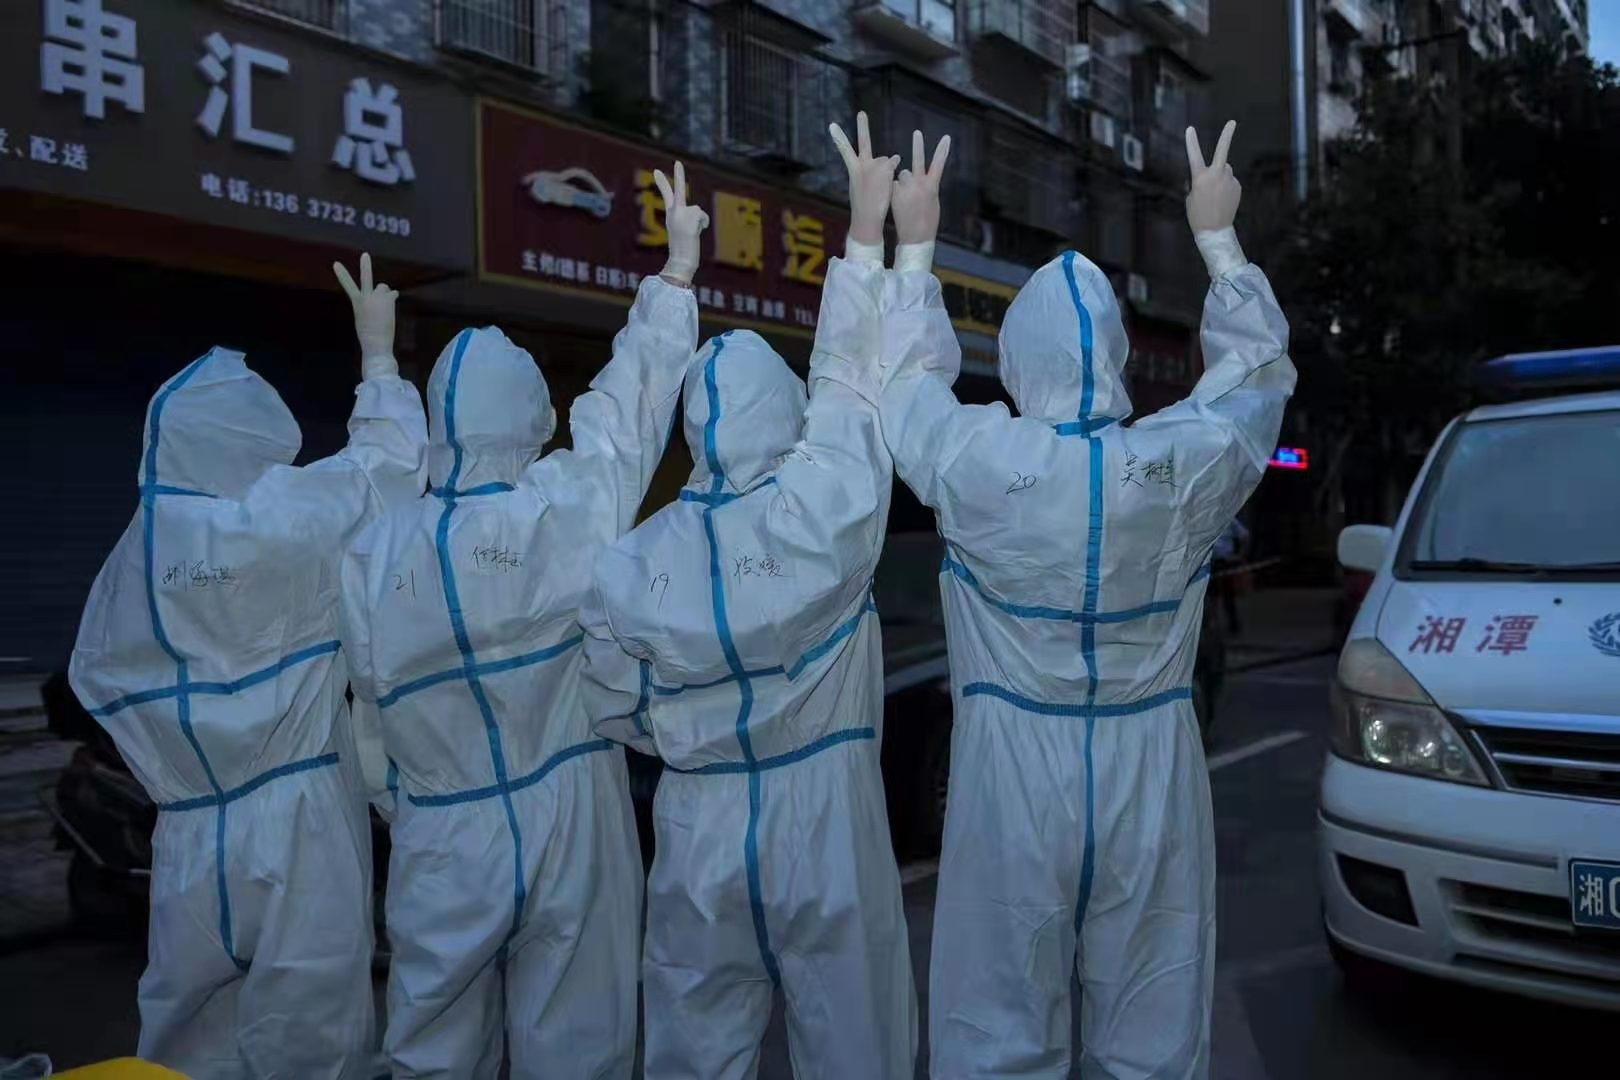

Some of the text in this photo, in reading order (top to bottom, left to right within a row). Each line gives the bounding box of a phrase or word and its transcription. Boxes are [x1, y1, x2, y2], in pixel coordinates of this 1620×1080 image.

[40, 0, 416, 186] 串汇总
[307, 198, 356, 226] 3732
[1005, 471, 1037, 495] 20
[395, 569, 416, 600] 21
[649, 572, 669, 607] 19
[1408, 615, 1539, 655] 湘潭
